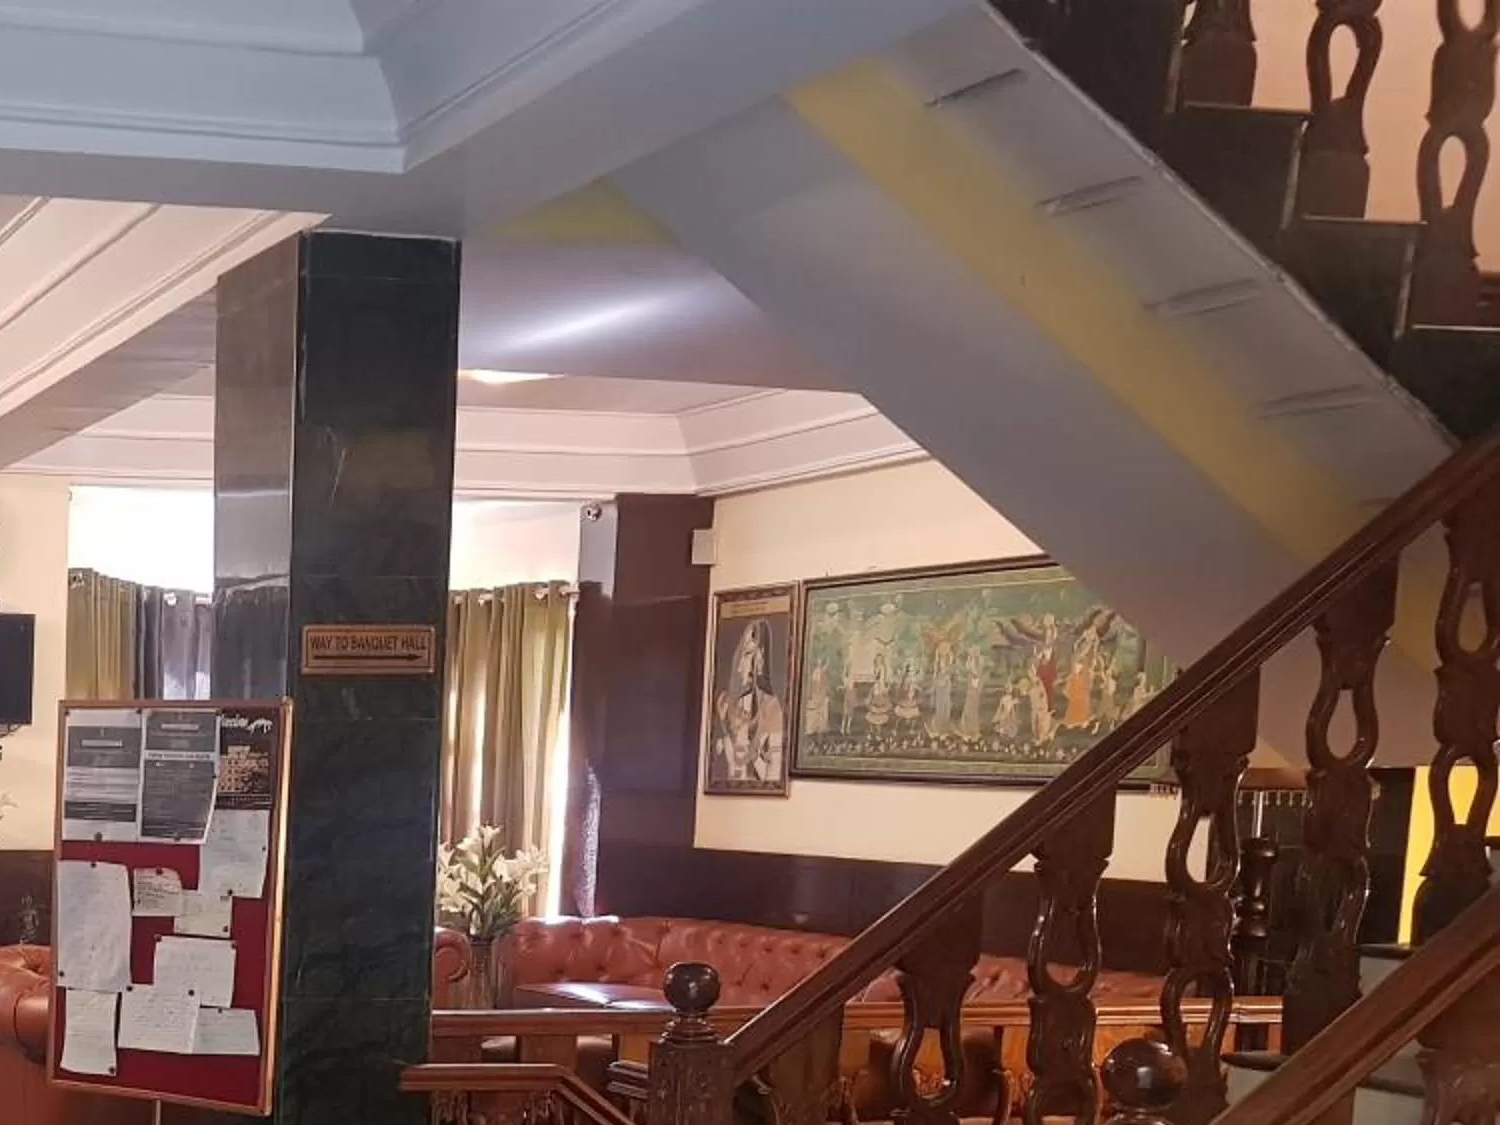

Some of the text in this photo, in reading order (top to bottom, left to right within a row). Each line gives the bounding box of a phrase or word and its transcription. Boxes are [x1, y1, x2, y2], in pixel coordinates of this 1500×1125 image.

[309, 635, 426, 650] WAY TO BANQUET HALL
